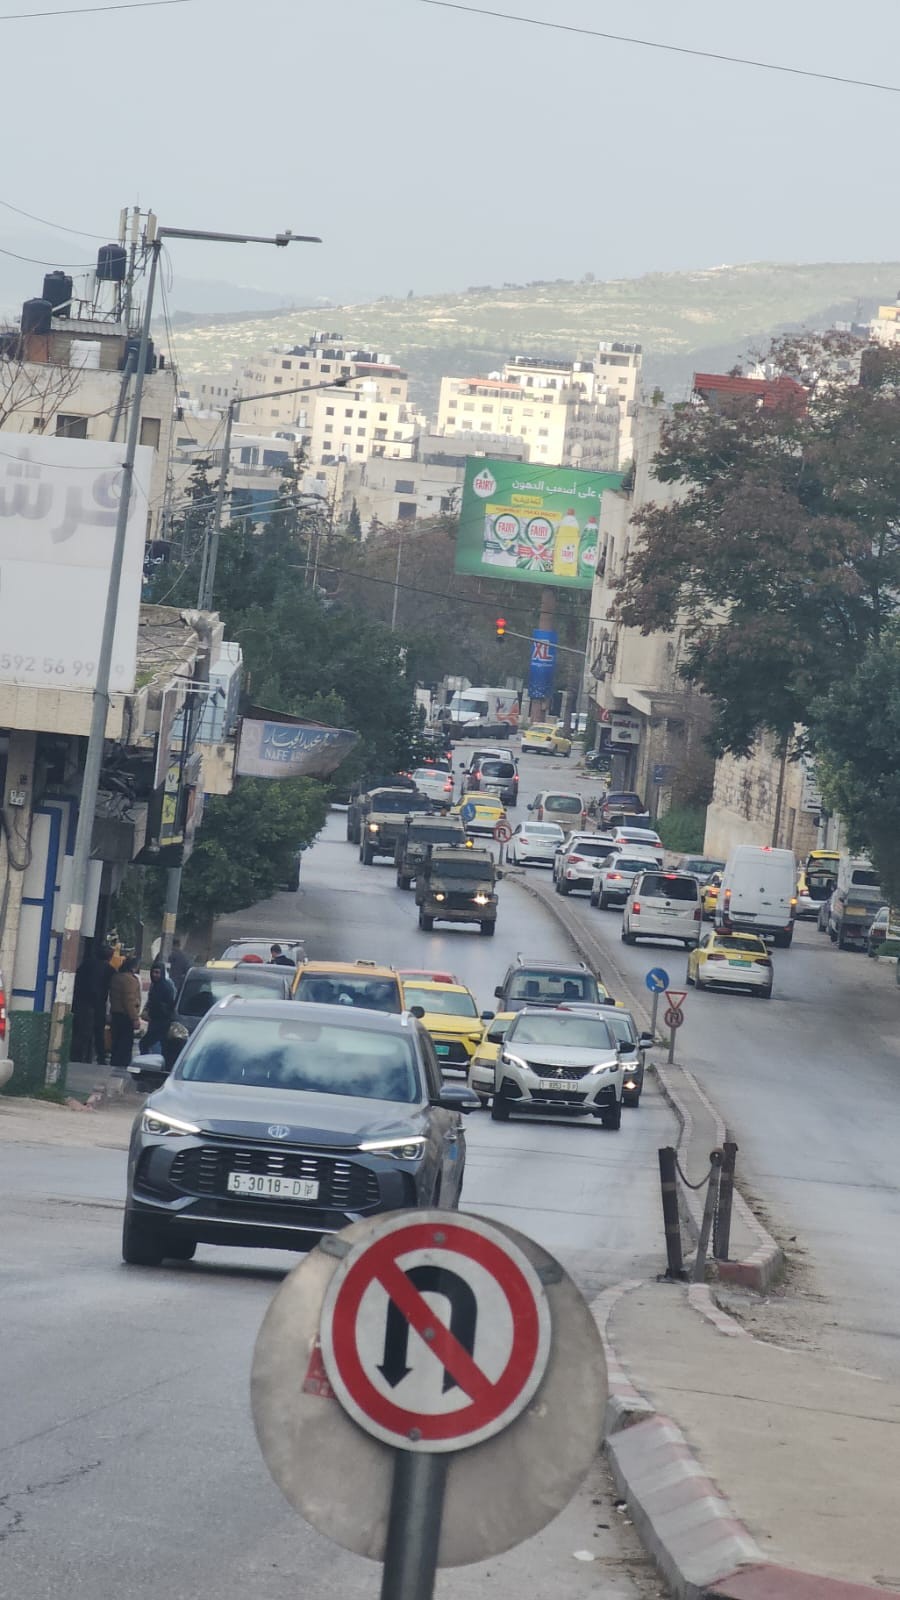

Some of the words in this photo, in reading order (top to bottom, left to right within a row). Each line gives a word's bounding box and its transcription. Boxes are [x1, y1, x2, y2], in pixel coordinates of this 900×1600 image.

[475, 479, 495, 491] FAIRY
[512, 480, 545, 491] الدهون
[546, 481, 576, 495] أصعب
[578, 487, 597, 499] على
[497, 521, 516, 533] FAIRY
[530, 524, 549, 537] FAIRY
[530, 639, 553, 661] XL
